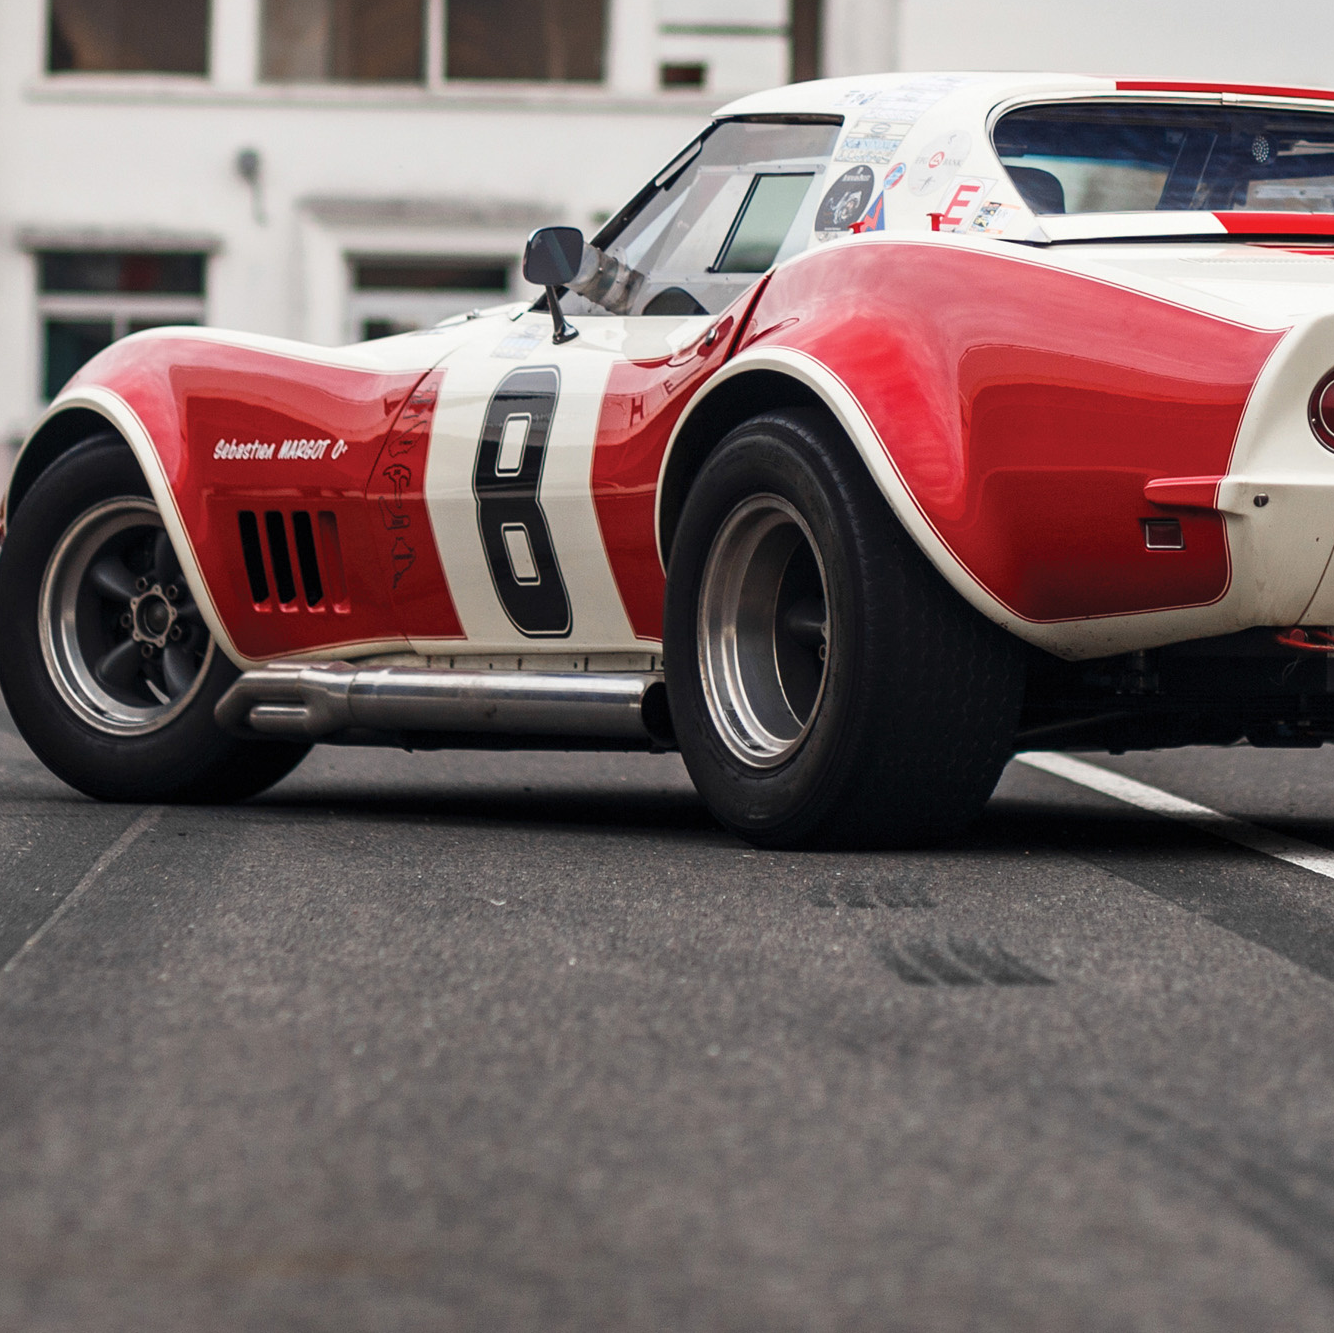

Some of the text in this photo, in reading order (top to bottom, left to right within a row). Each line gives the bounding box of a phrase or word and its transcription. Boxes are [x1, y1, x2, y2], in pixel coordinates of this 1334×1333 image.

[941, 184, 981, 226] E
[213, 438, 276, 460] Sebastien
[277, 439, 331, 460] MARGOT
[471, 364, 573, 639] 8
